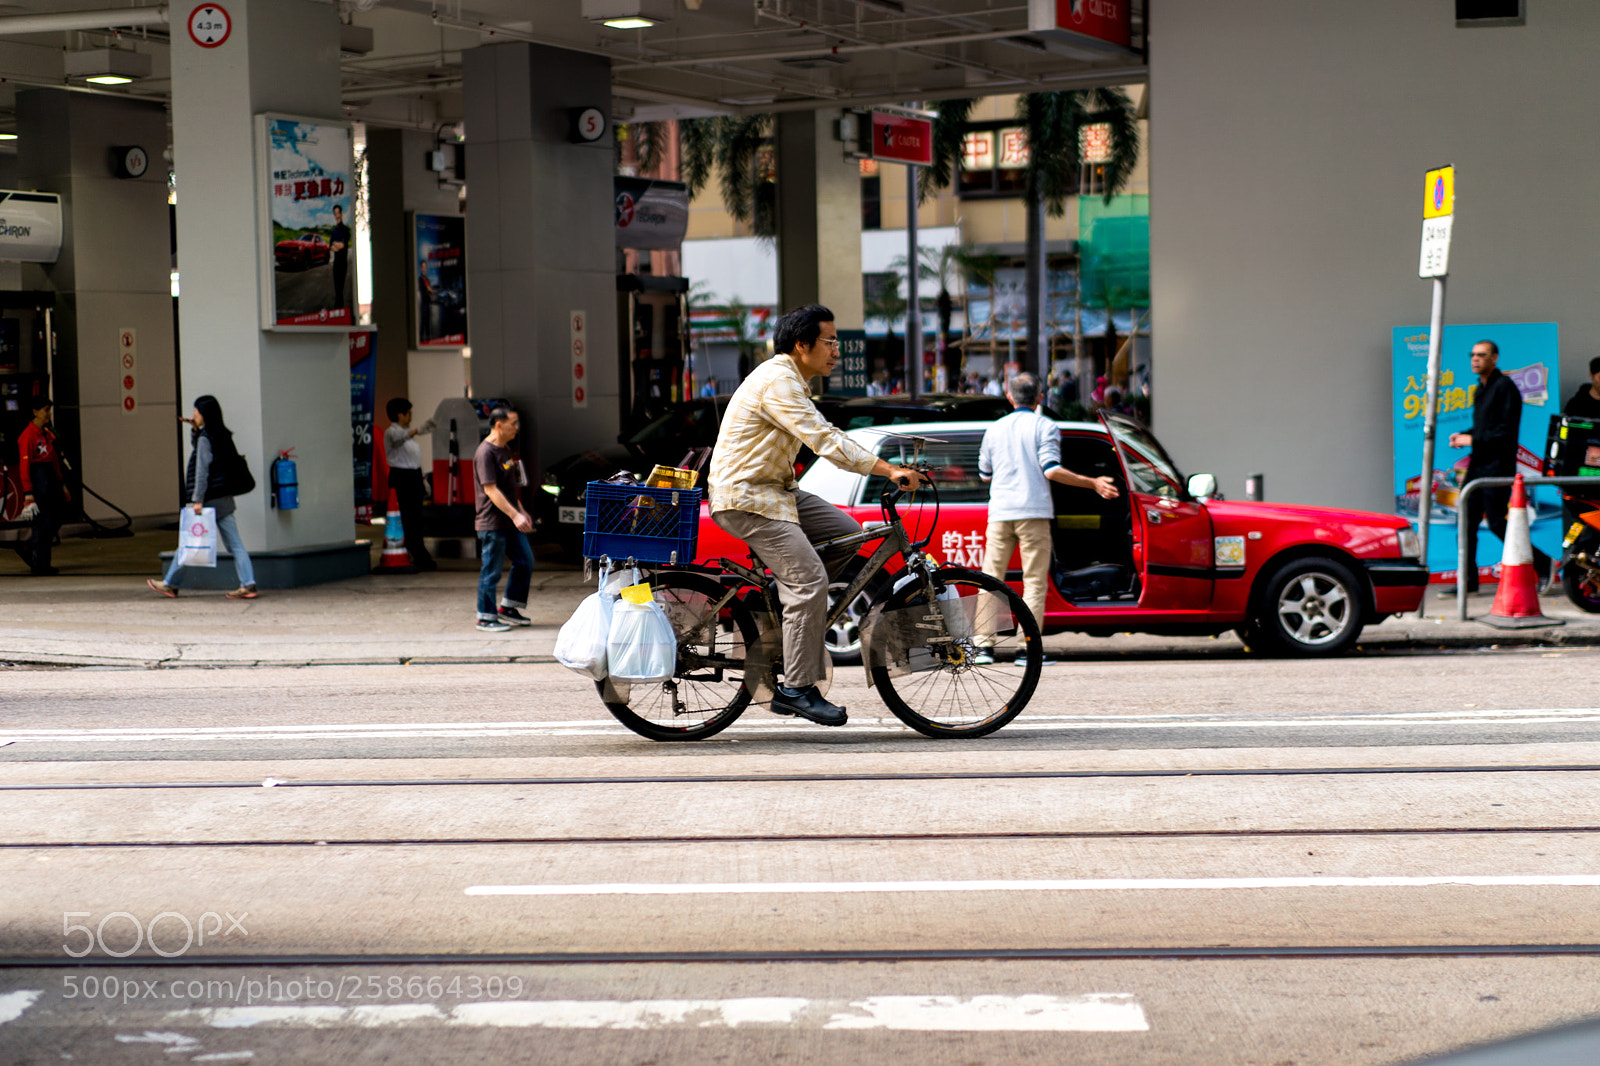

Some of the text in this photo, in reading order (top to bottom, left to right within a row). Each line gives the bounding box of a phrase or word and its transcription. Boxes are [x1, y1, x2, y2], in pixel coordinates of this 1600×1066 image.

[197, 22, 212, 30] 4.3
[586, 116, 595, 133] 5
[562, 509, 575, 522] PS
[942, 530, 984, 549] 的士
[942, 548, 984, 568] TAXI
